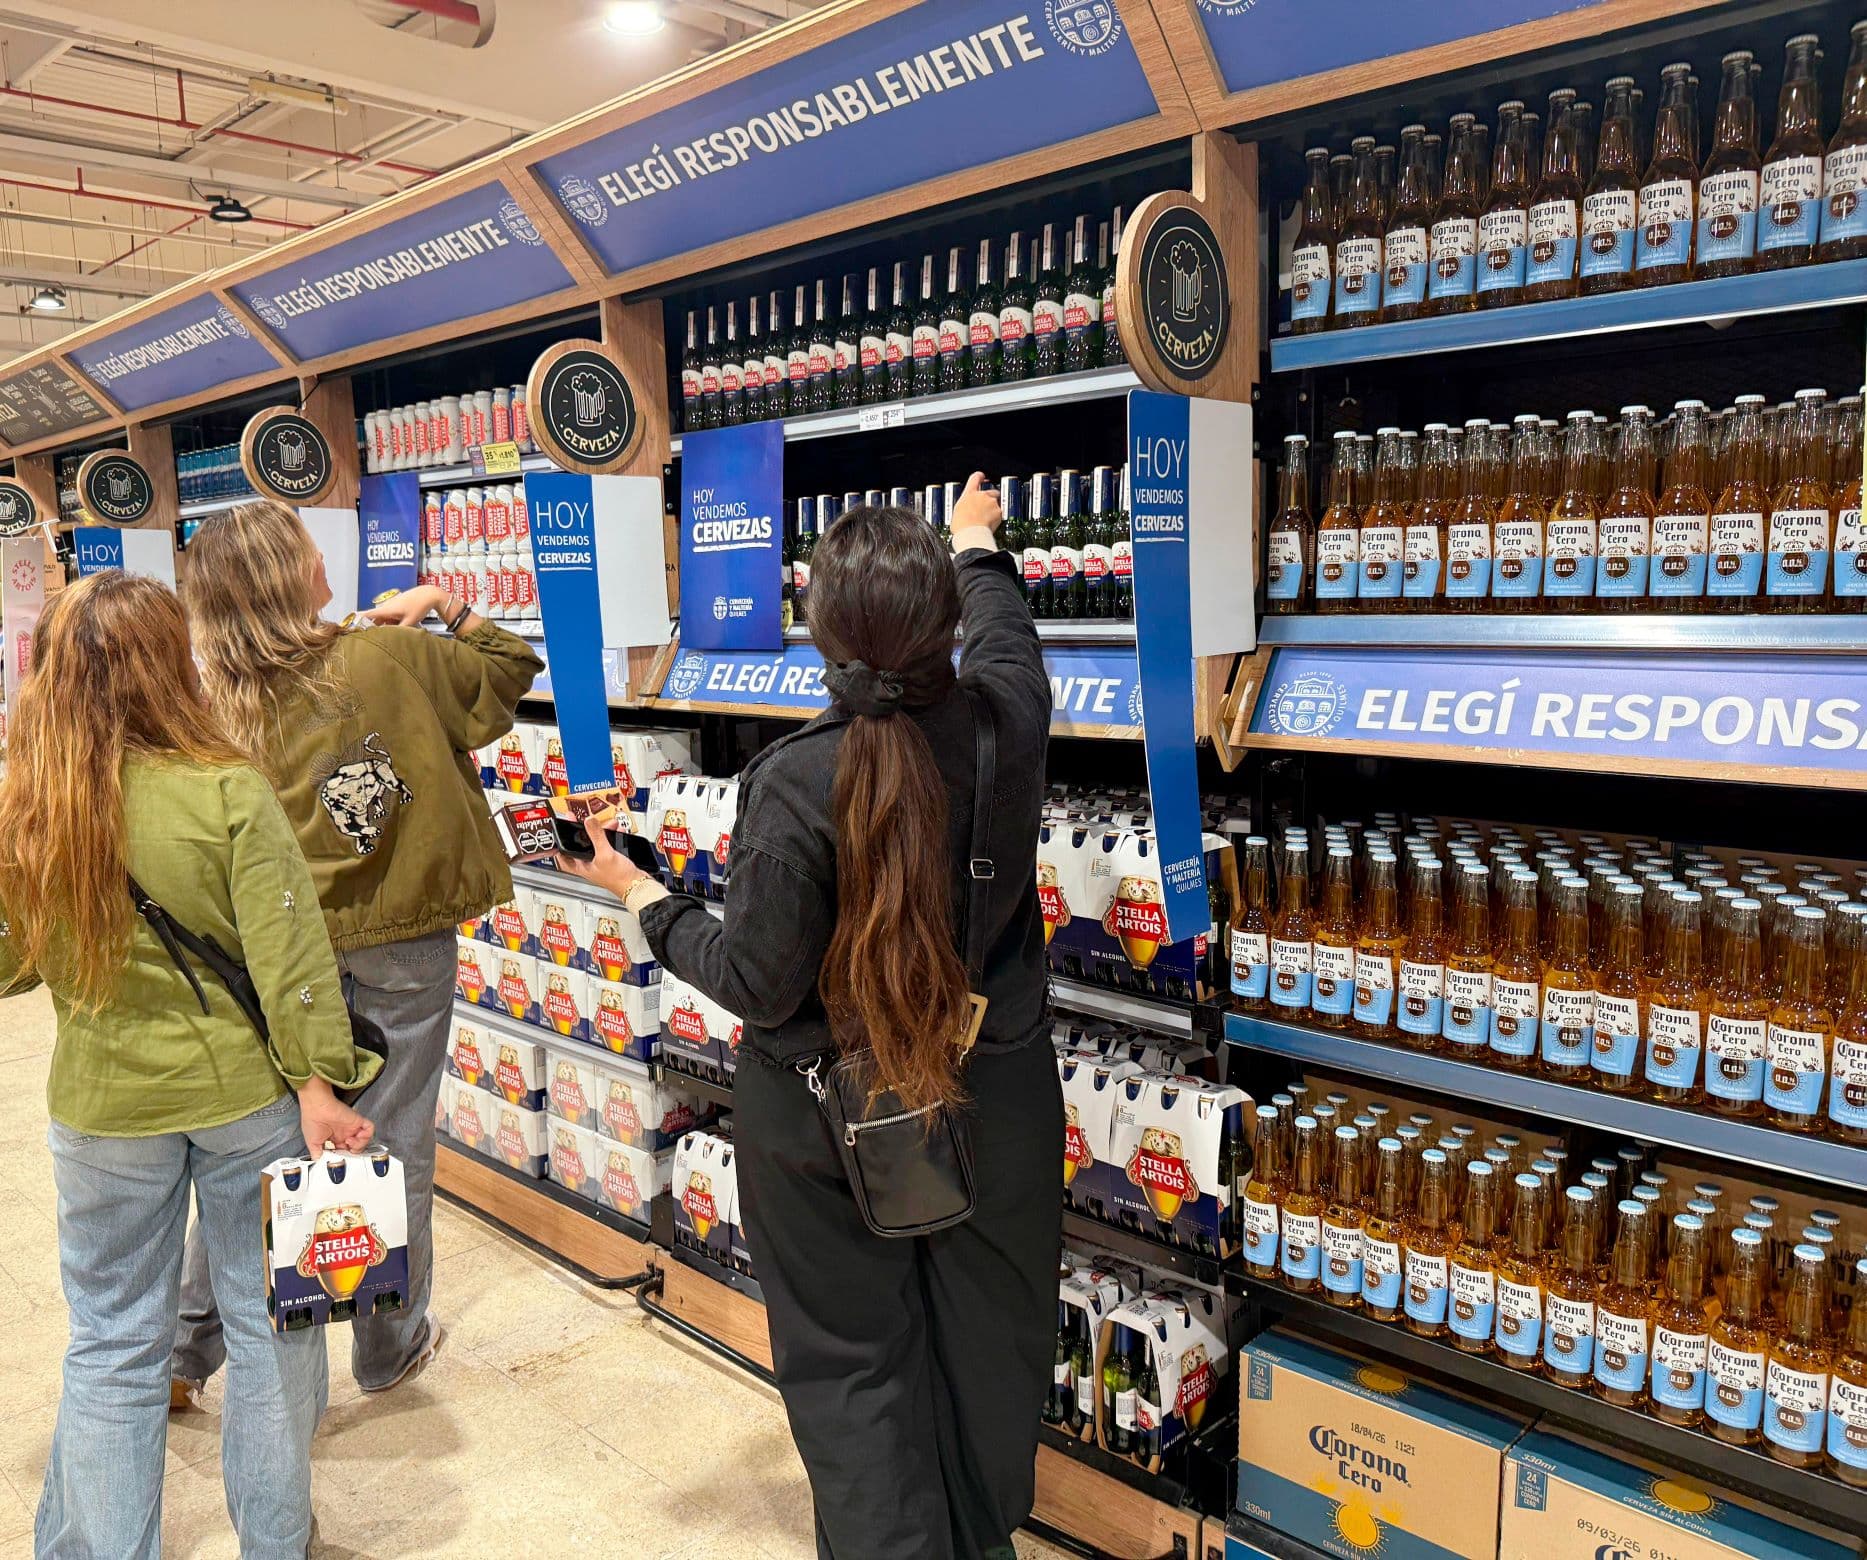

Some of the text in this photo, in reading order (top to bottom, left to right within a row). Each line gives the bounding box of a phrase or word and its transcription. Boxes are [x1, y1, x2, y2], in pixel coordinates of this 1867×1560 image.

[598, 143, 681, 207] ELEGÍ
[673, 14, 1045, 181] RESPONSABLEMENTE
[1764, 164, 1813, 184] Corona
[1702, 179, 1748, 197] Corona
[1775, 179, 1800, 189] Cero
[1586, 195, 1628, 212] Corona
[1712, 193, 1735, 202] Cero
[1595, 209, 1615, 217] Cero
[1338, 243, 1373, 257] Corona
[273, 278, 323, 318] ELEGÍ
[319, 217, 509, 305] RESPONSABLEMENTE
[97, 316, 231, 379] ELEGÍ RESPONSABLEMENTE
[1159, 321, 1213, 361] CERVEZA
[563, 427, 620, 452] CERVEZA
[1136, 435, 1185, 479] HOY
[269, 470, 319, 490] CERVEZA
[693, 489, 714, 505] HOY
[1135, 488, 1184, 505] VENDEMOS
[101, 500, 143, 515] CERVEZA
[536, 501, 589, 529] HOY
[693, 502, 747, 521] VENDEMOS
[367, 519, 379, 531] HOY
[692, 516, 772, 543] CERVEZAS
[1134, 515, 1184, 532] CERVEZAS
[1549, 523, 1588, 537] Corona
[1656, 520, 1700, 535] Corona
[1774, 514, 1821, 530] Corona
[367, 530, 400, 542] VENDEMOS
[1556, 536, 1576, 544] Cero
[1665, 533, 1687, 541] Cero
[1784, 528, 1808, 537] Cero
[536, 535, 590, 547] VENDEMOS
[81, 544, 120, 562] HOY
[367, 542, 414, 561] CERVEZAS
[538, 551, 591, 564] CERVEZAS
[12, 559, 37, 575] STELLA
[11, 575, 37, 592] ARTOIS
[706, 656, 784, 693] ELEGÍ
[1268, 683, 1288, 735] CERVECERÍA
[1334, 684, 1348, 722] QUILMES
[1355, 676, 1867, 751] ELEGÍ RESPONS
[501, 754, 523, 766] STELLA
[548, 761, 566, 772] STELL
[501, 763, 524, 774] ARTOIS
[574, 781, 612, 792] CERVECERÍA
[663, 830, 687, 841] STELLA
[663, 839, 688, 850] ARTOIS
[1164, 855, 1200, 876] CERVECERÍA
[1172, 867, 1201, 885] MALTERÍA
[1175, 879, 1202, 894] QUILMES
[1116, 906, 1160, 921] STELLA
[546, 926, 569, 939] STELLA
[1116, 918, 1161, 934] ARTOIS
[546, 935, 570, 947] ARTOIS
[598, 939, 622, 953] STELLA
[598, 948, 624, 962] ARTOIS
[1401, 962, 1437, 977] Corona
[1408, 977, 1426, 985] Cero
[549, 994, 571, 1008] STELLA
[1548, 991, 1592, 1005] Corona
[549, 1004, 572, 1017] ARTOIS
[601, 1011, 624, 1024] STELLA
[1560, 1005, 1581, 1015] Cero
[601, 1020, 625, 1035] ARTOIS
[675, 1014, 700, 1027] STELLA
[675, 1022, 700, 1035] ARTOIS
[1711, 1018, 1760, 1035] Corona
[1722, 1034, 1747, 1045] Cero
[1770, 1028, 1815, 1047] Corona
[1778, 1044, 1800, 1056] Cero
[500, 1065, 519, 1079] STELLA
[500, 1074, 520, 1089] ARTOIS
[1139, 1156, 1184, 1178] STELLA
[608, 1173, 632, 1189] STELLA
[1140, 1170, 1185, 1189] ARTOIS
[608, 1183, 633, 1199] ARTOIS
[688, 1192, 711, 1208] STELLA
[688, 1200, 711, 1217] ARTOIS
[1325, 1226, 1360, 1241] Corona
[314, 1234, 369, 1253] STELLA
[1333, 1240, 1350, 1249] Cero
[314, 1245, 370, 1265] ARTOIS
[1452, 1266, 1486, 1284] Corona
[295, 1294, 326, 1306] ALCOHOL
[1660, 1331, 1704, 1348] Corona
[1672, 1348, 1694, 1358] Cero
[1712, 1345, 1757, 1367] Corona
[1255, 1366, 1264, 1377] 24
[1722, 1363, 1744, 1376] Cero
[1771, 1365, 1817, 1388] Corona
[1182, 1371, 1209, 1394] STELLA
[1781, 1384, 1804, 1397] Cero
[1182, 1382, 1210, 1405] ARTOIS
[1308, 1425, 1407, 1484] Corona
[1521, 1453, 1557, 1472] 330ml
[1338, 1460, 1382, 1493] Cero
[1526, 1471, 1537, 1484] 24
[1520, 1490, 1540, 1504] CORONA
[1245, 1501, 1271, 1521] 330ml
[1623, 1496, 1713, 1536] CERVEZA SIN ALCOHOL
[1577, 1518, 1641, 1553] 09/03/26
[1322, 1540, 1348, 1559] CERVEZA
